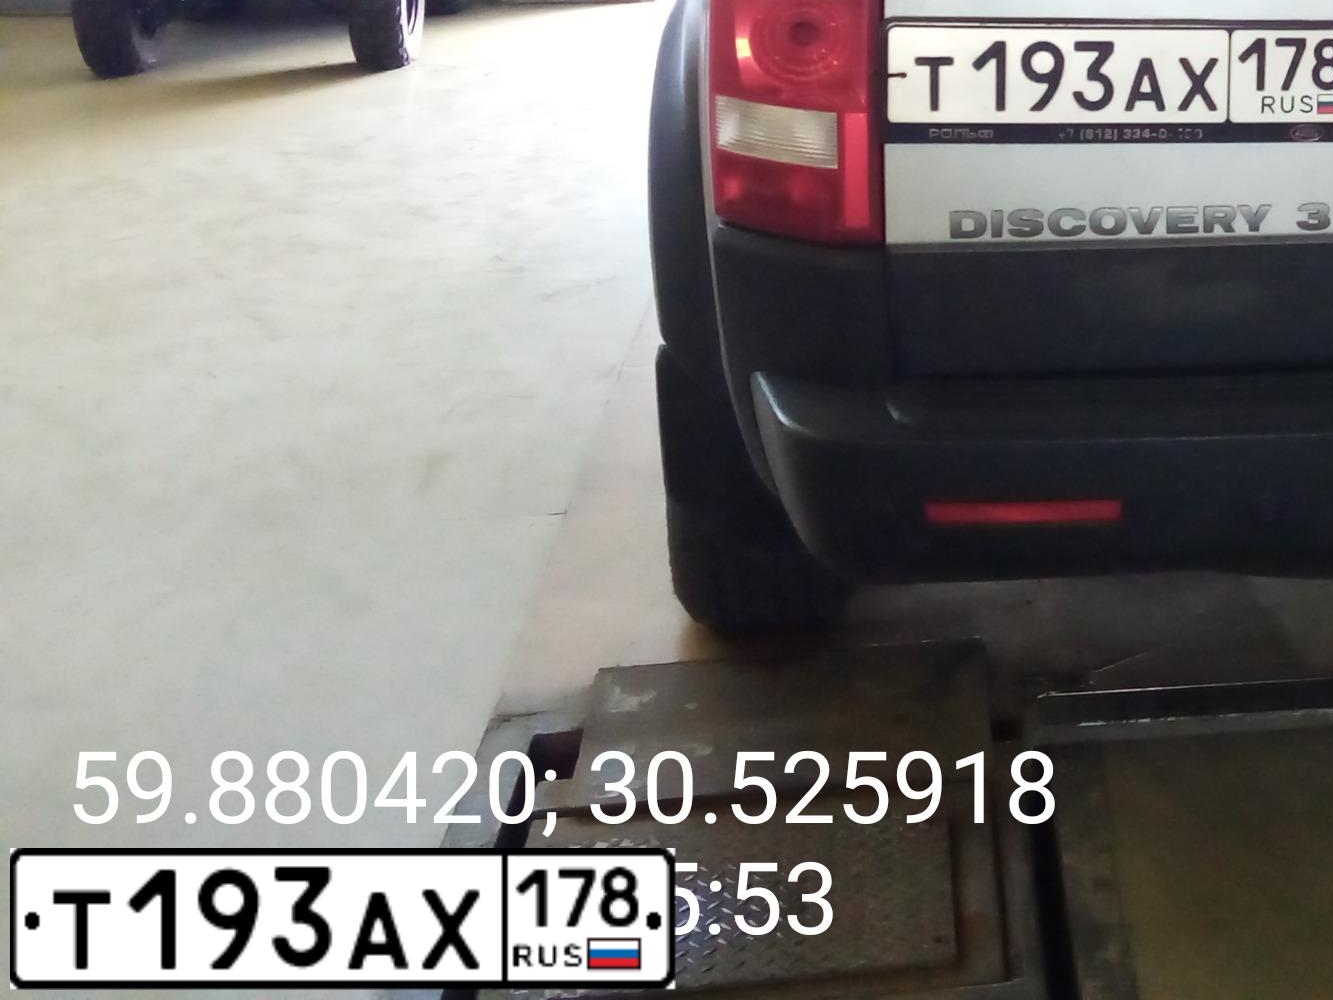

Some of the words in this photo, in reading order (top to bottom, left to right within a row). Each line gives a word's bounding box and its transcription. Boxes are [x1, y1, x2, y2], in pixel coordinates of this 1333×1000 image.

[914, 40, 1220, 112] T193AX
[1261, 95, 1314, 115] RUS
[948, 204, 1273, 240] DISCOVERY
[1295, 202, 1332, 233] 3
